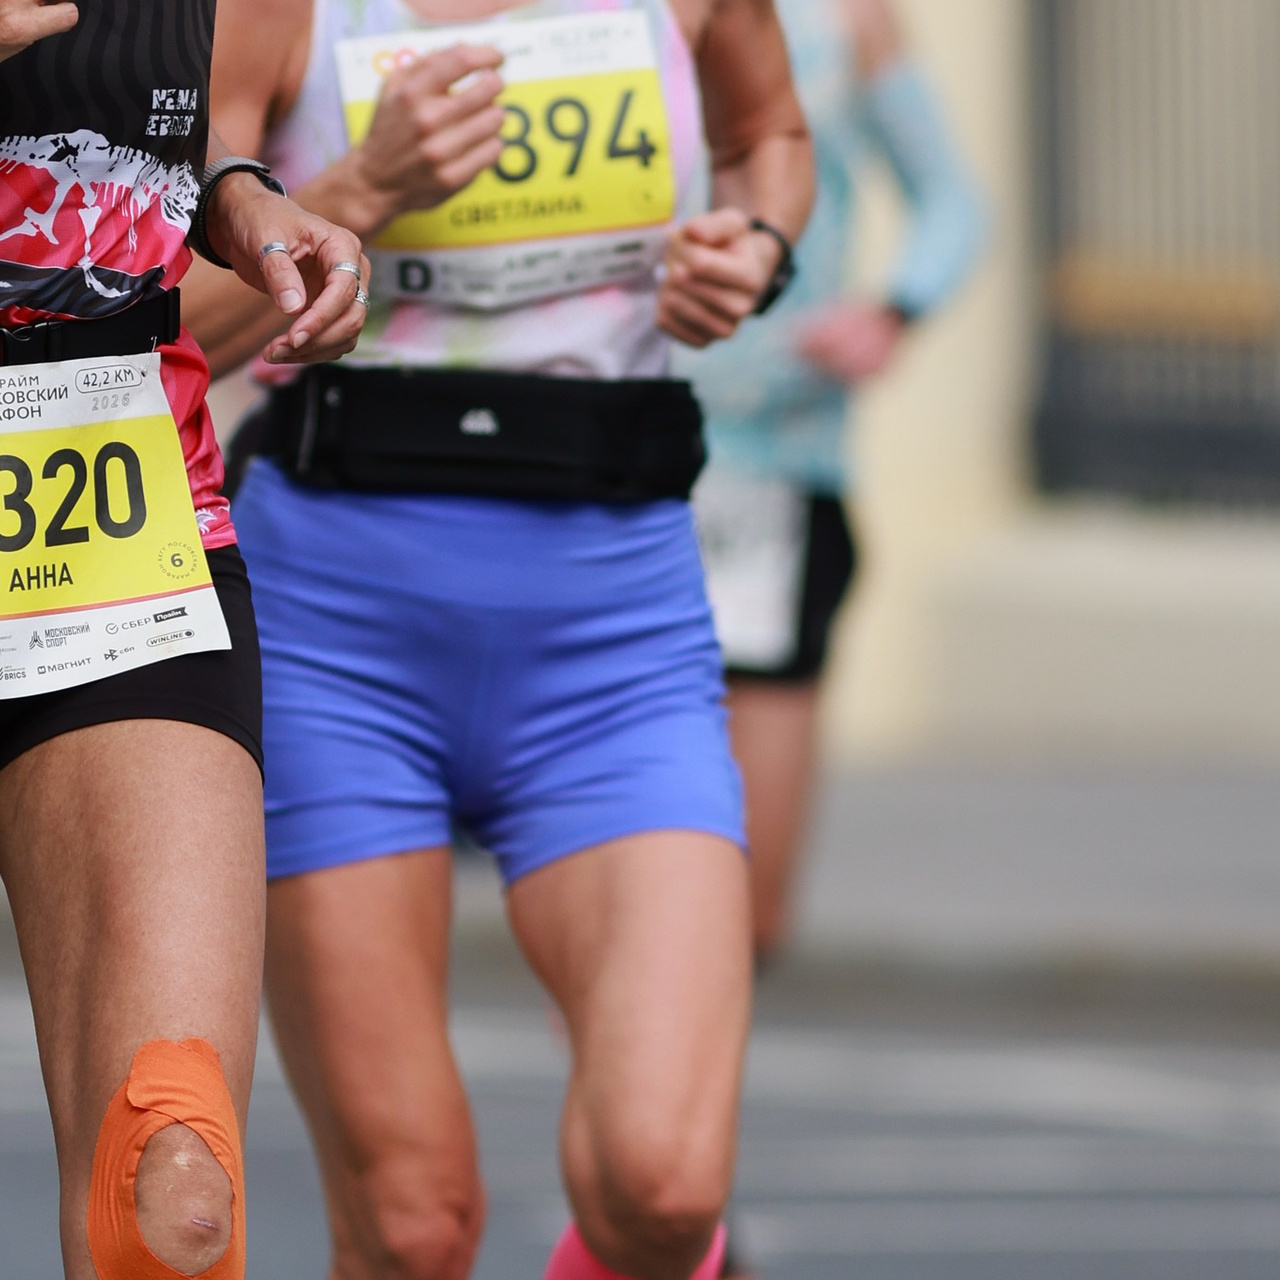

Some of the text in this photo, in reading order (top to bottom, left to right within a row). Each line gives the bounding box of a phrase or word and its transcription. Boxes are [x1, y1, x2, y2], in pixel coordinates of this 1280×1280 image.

[493, 87, 656, 183] 894
[398, 259, 433, 292] D
[82, 371, 110, 388] 42,2
[91, 392, 131, 411] 2026
[171, 553, 183, 567] 6
[8, 562, 74, 593] АННА
[45, 622, 90, 638] МОСКОВСКИЙ
[121, 617, 151, 630] СБЕР
[46, 638, 67, 648] СПОРТ
[150, 632, 184, 645] WINLINE
[4, 671, 26, 680] BRICS
